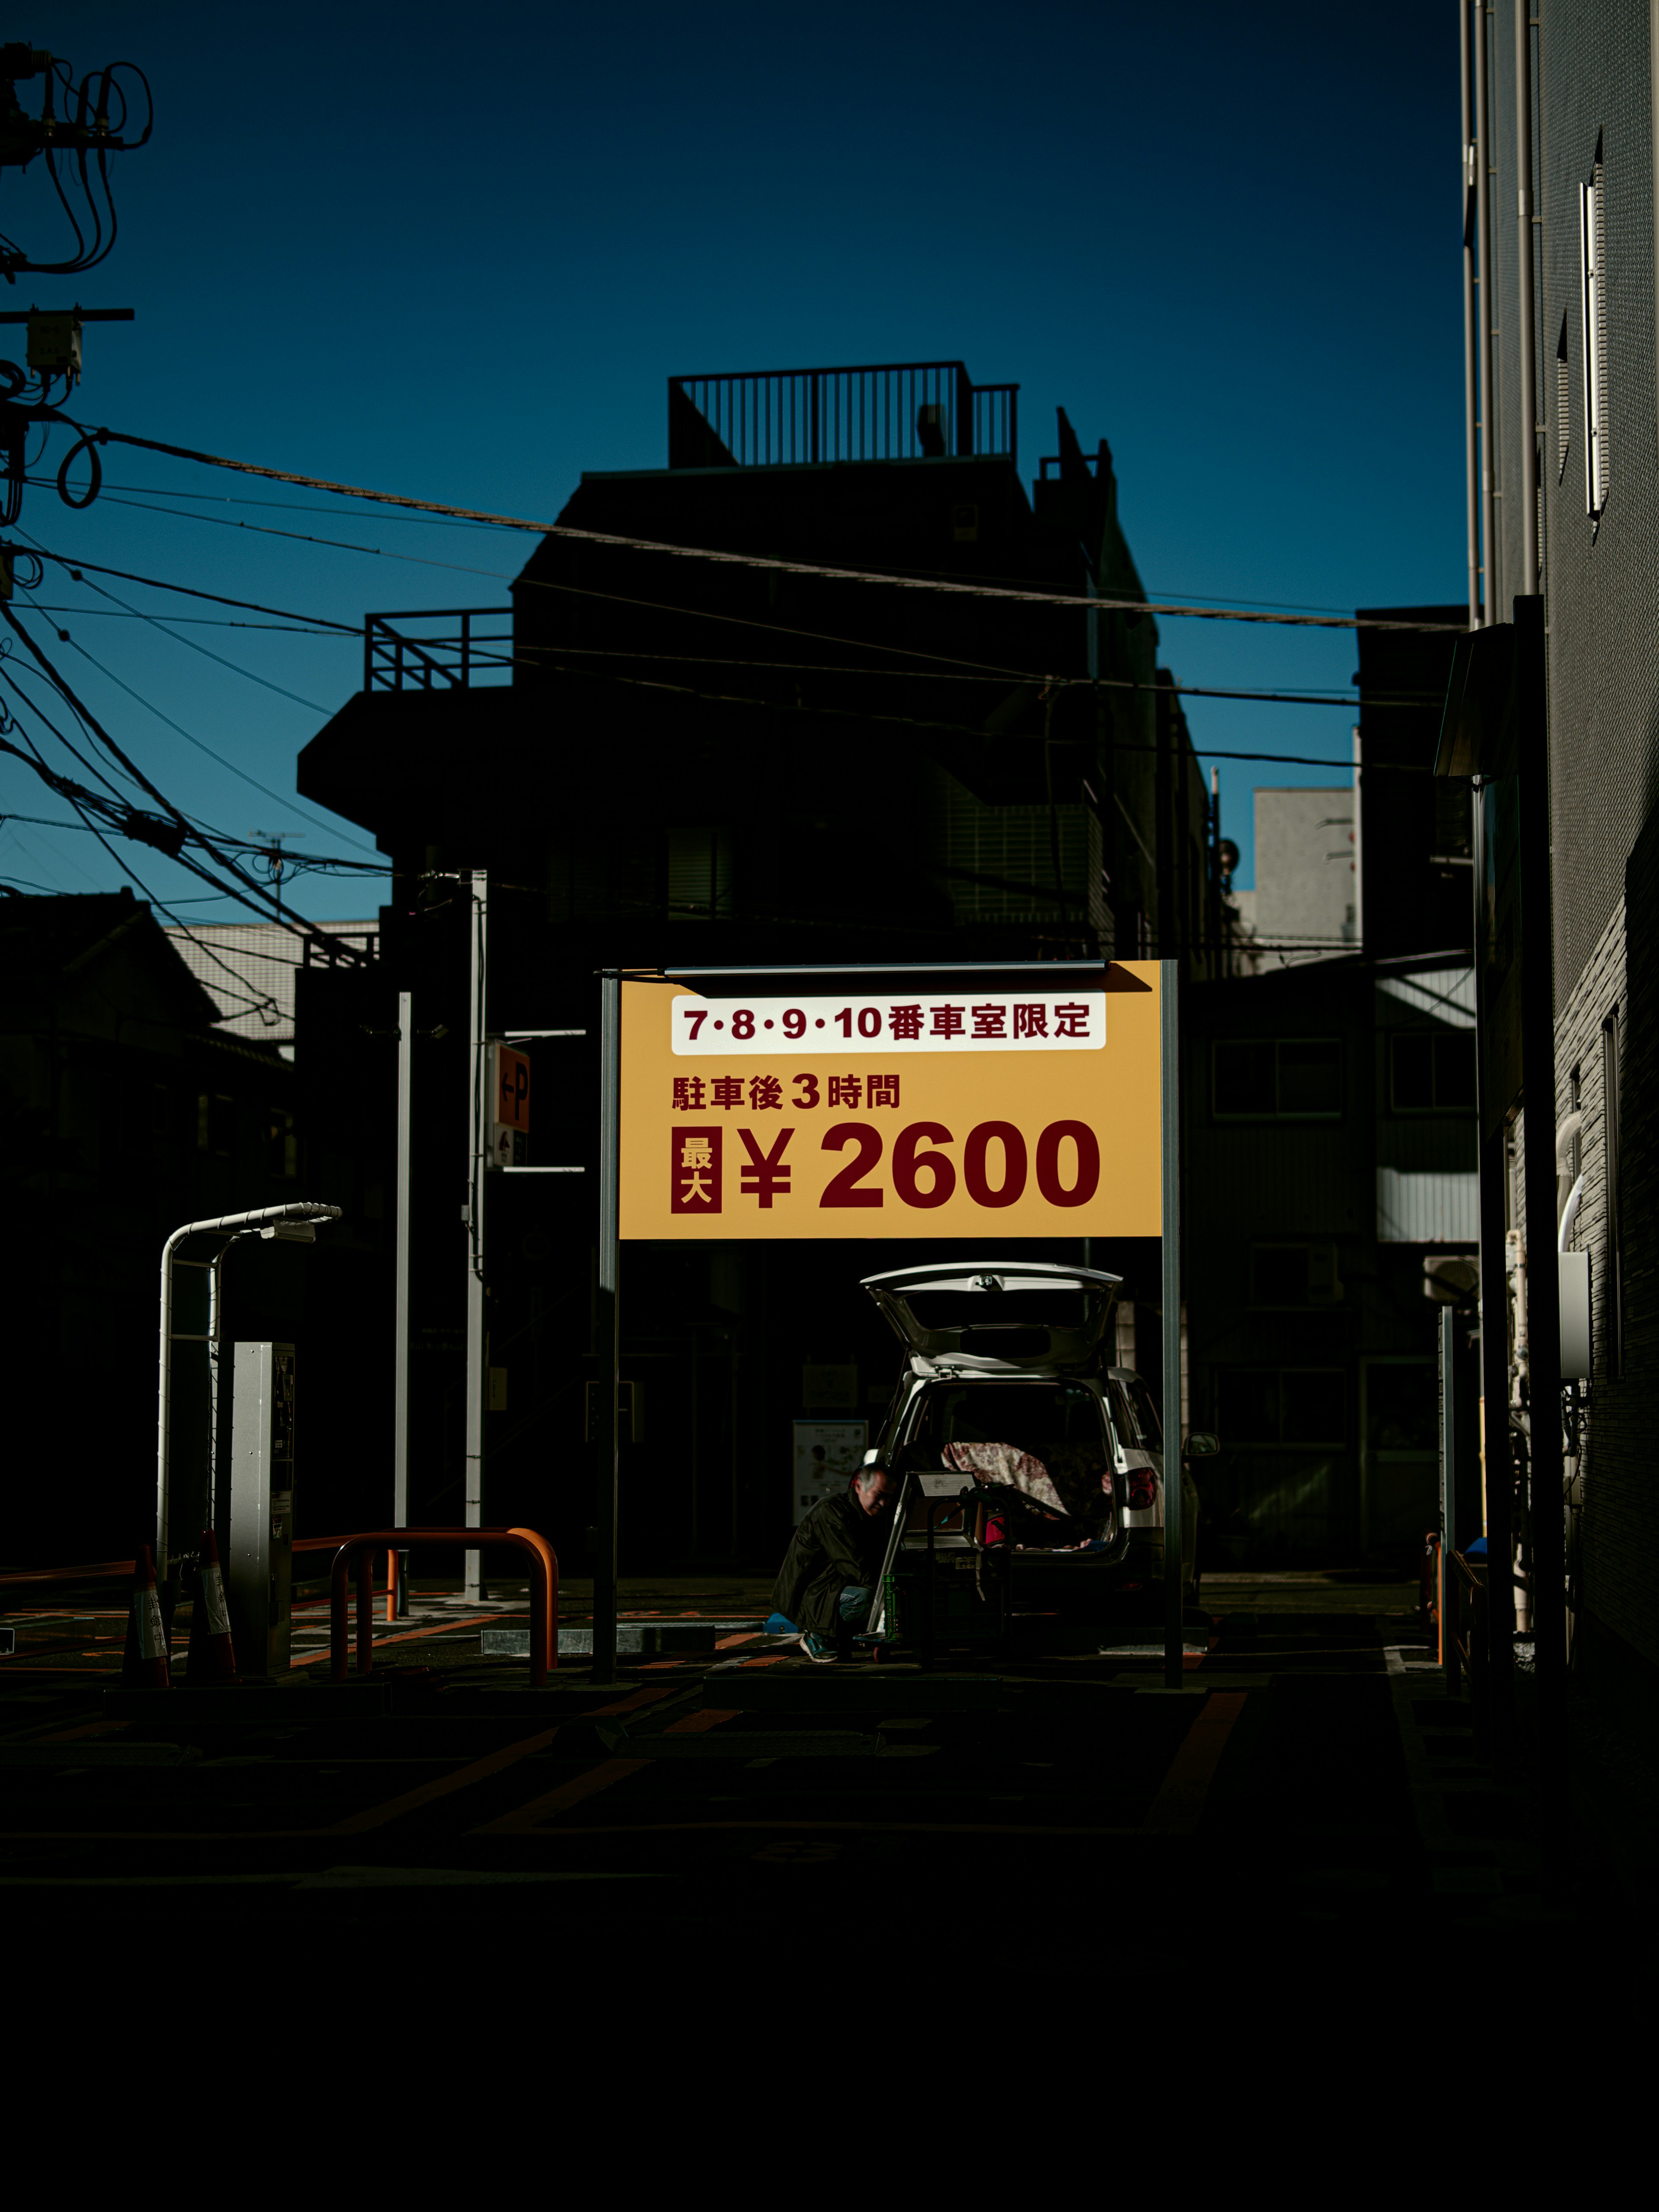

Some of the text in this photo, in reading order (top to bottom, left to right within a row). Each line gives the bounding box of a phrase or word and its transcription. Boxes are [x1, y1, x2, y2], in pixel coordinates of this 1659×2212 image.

[515, 1062, 528, 1120] P
[671, 1072, 900, 1111] 駐車後3時間
[680, 1137, 713, 1204] 最大
